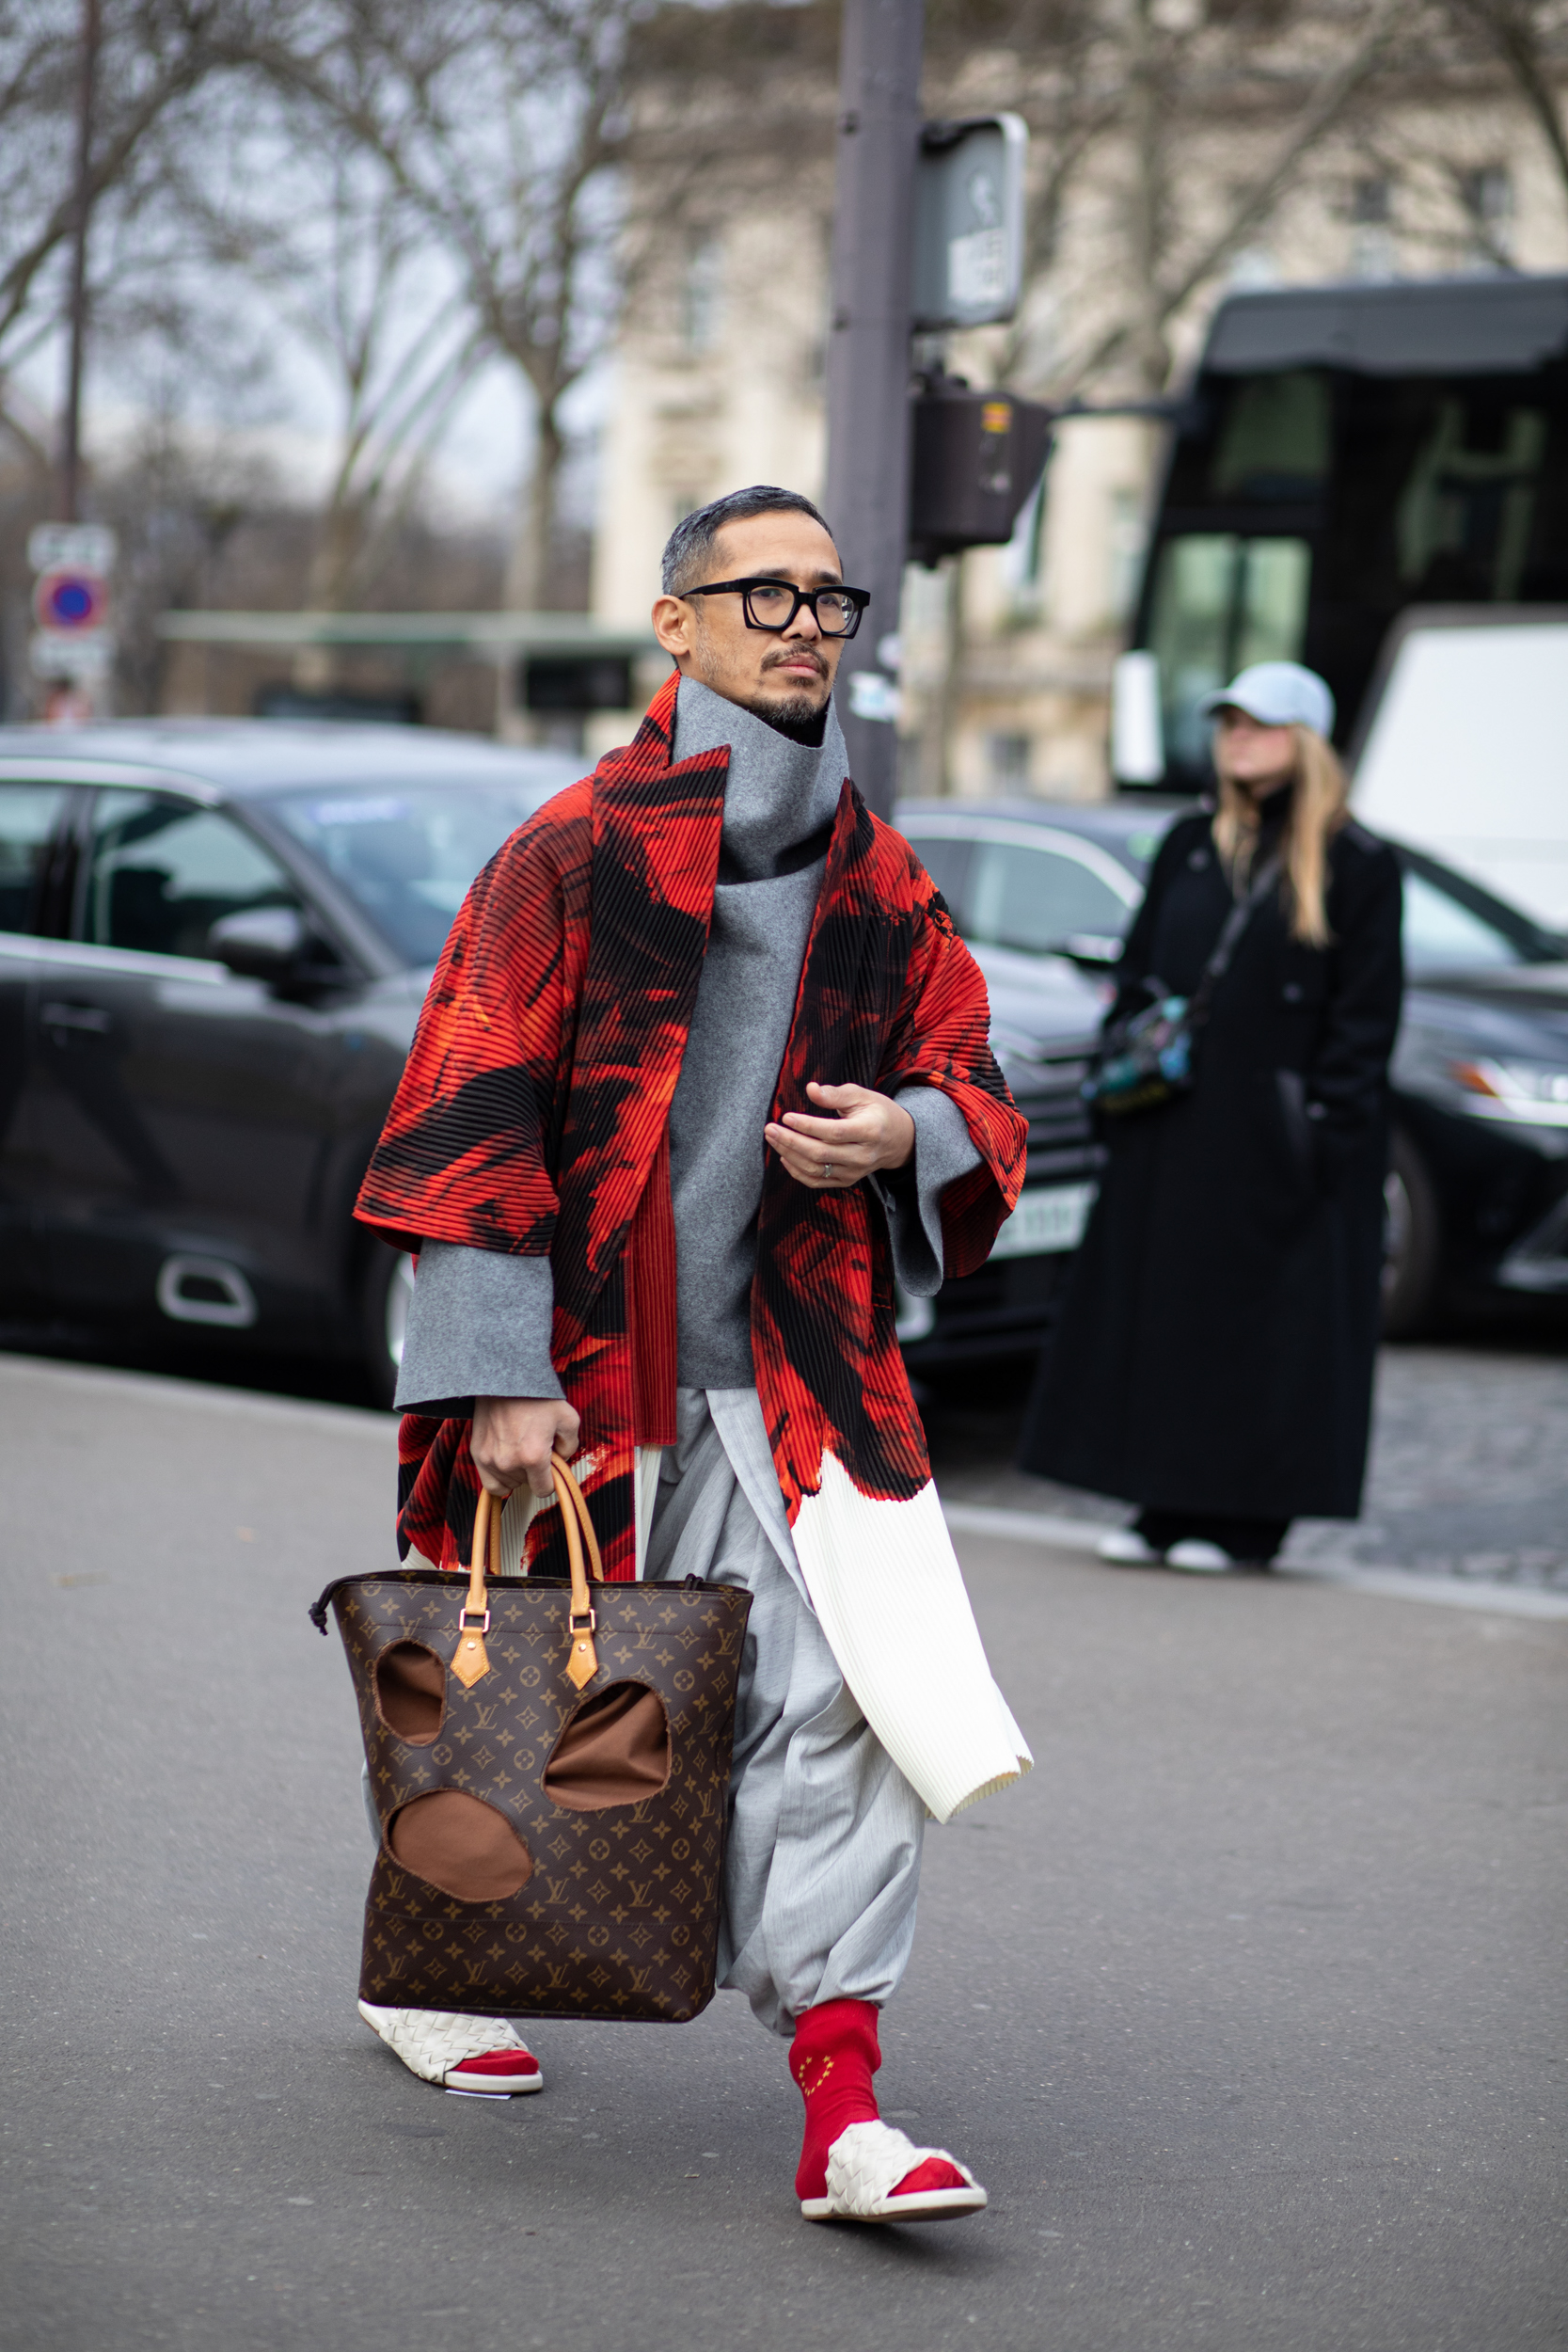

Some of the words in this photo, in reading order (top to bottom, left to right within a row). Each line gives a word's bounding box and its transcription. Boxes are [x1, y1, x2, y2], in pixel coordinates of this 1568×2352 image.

[633, 1622, 658, 1649] LV
[715, 1628, 738, 1655] LV
[473, 1702, 499, 1730] LV
[697, 1710, 721, 1735] LV
[697, 1789, 716, 1819] LV
[387, 1869, 406, 1899] LV
[545, 1876, 570, 1905] LV
[627, 1880, 654, 1908] LV
[385, 1950, 408, 1980] LV
[462, 1959, 488, 1986] LV
[546, 1962, 571, 1989] LV
[627, 1965, 654, 1993] LV
